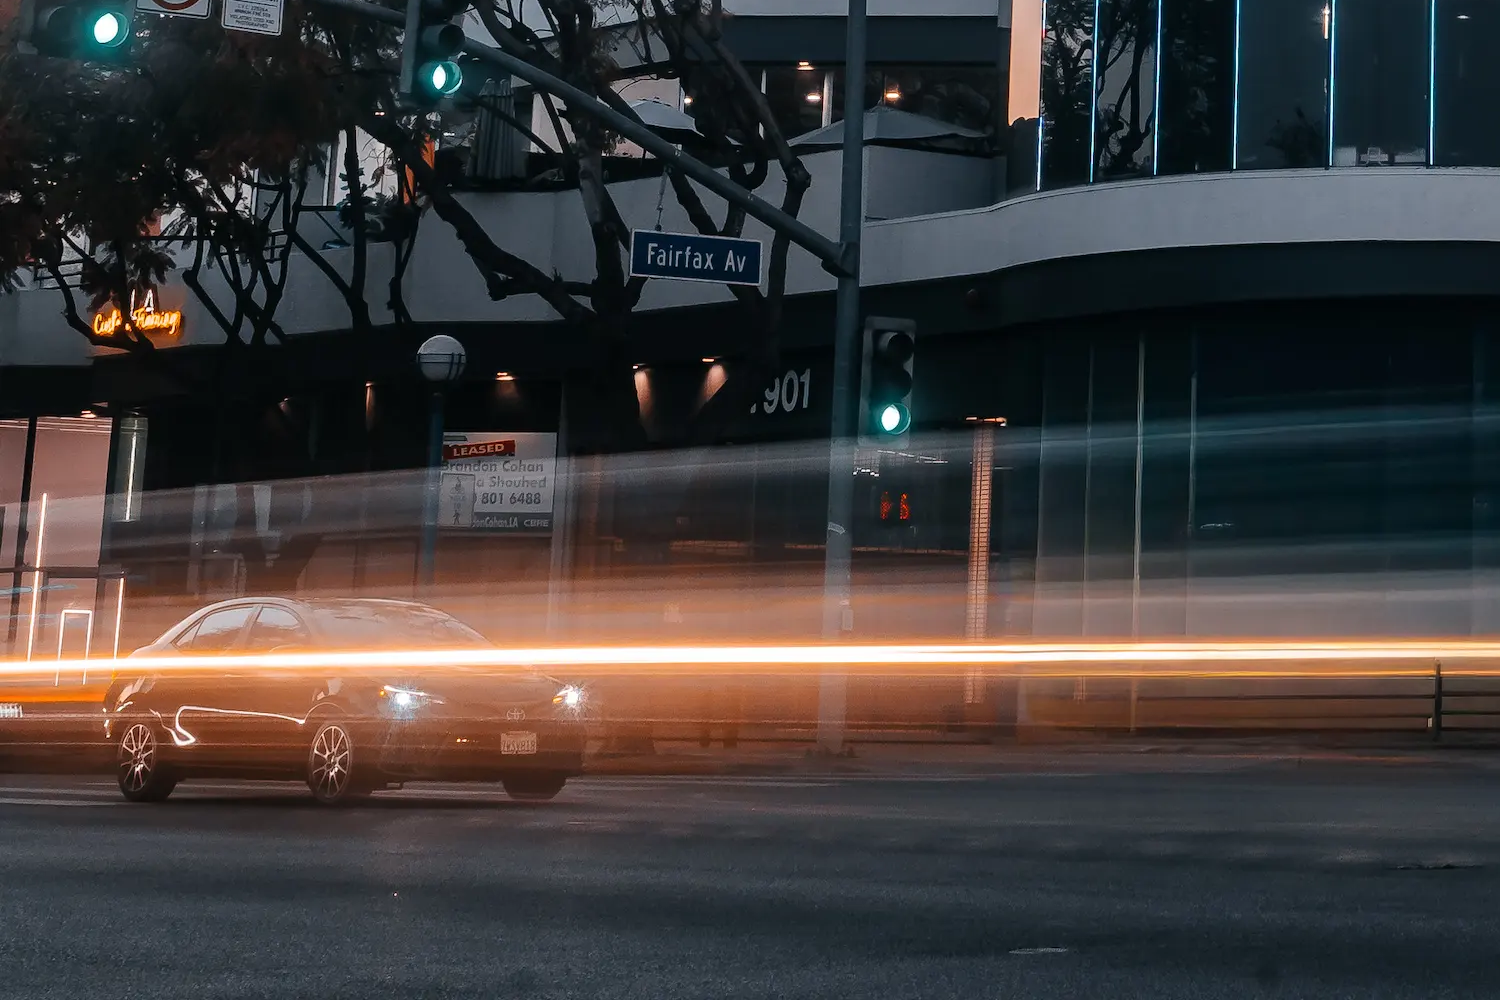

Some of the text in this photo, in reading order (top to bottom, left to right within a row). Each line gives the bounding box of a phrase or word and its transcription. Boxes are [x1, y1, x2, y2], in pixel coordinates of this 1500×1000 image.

[647, 242, 746, 273] Fairfax Av
[129, 289, 154, 320] LA
[750, 368, 811, 414] 901
[453, 443, 505, 457] LEASED
[502, 460, 544, 472] Cohan
[489, 475, 547, 488] Shouhed
[481, 492, 504, 505] 801
[509, 492, 541, 505] 6488
